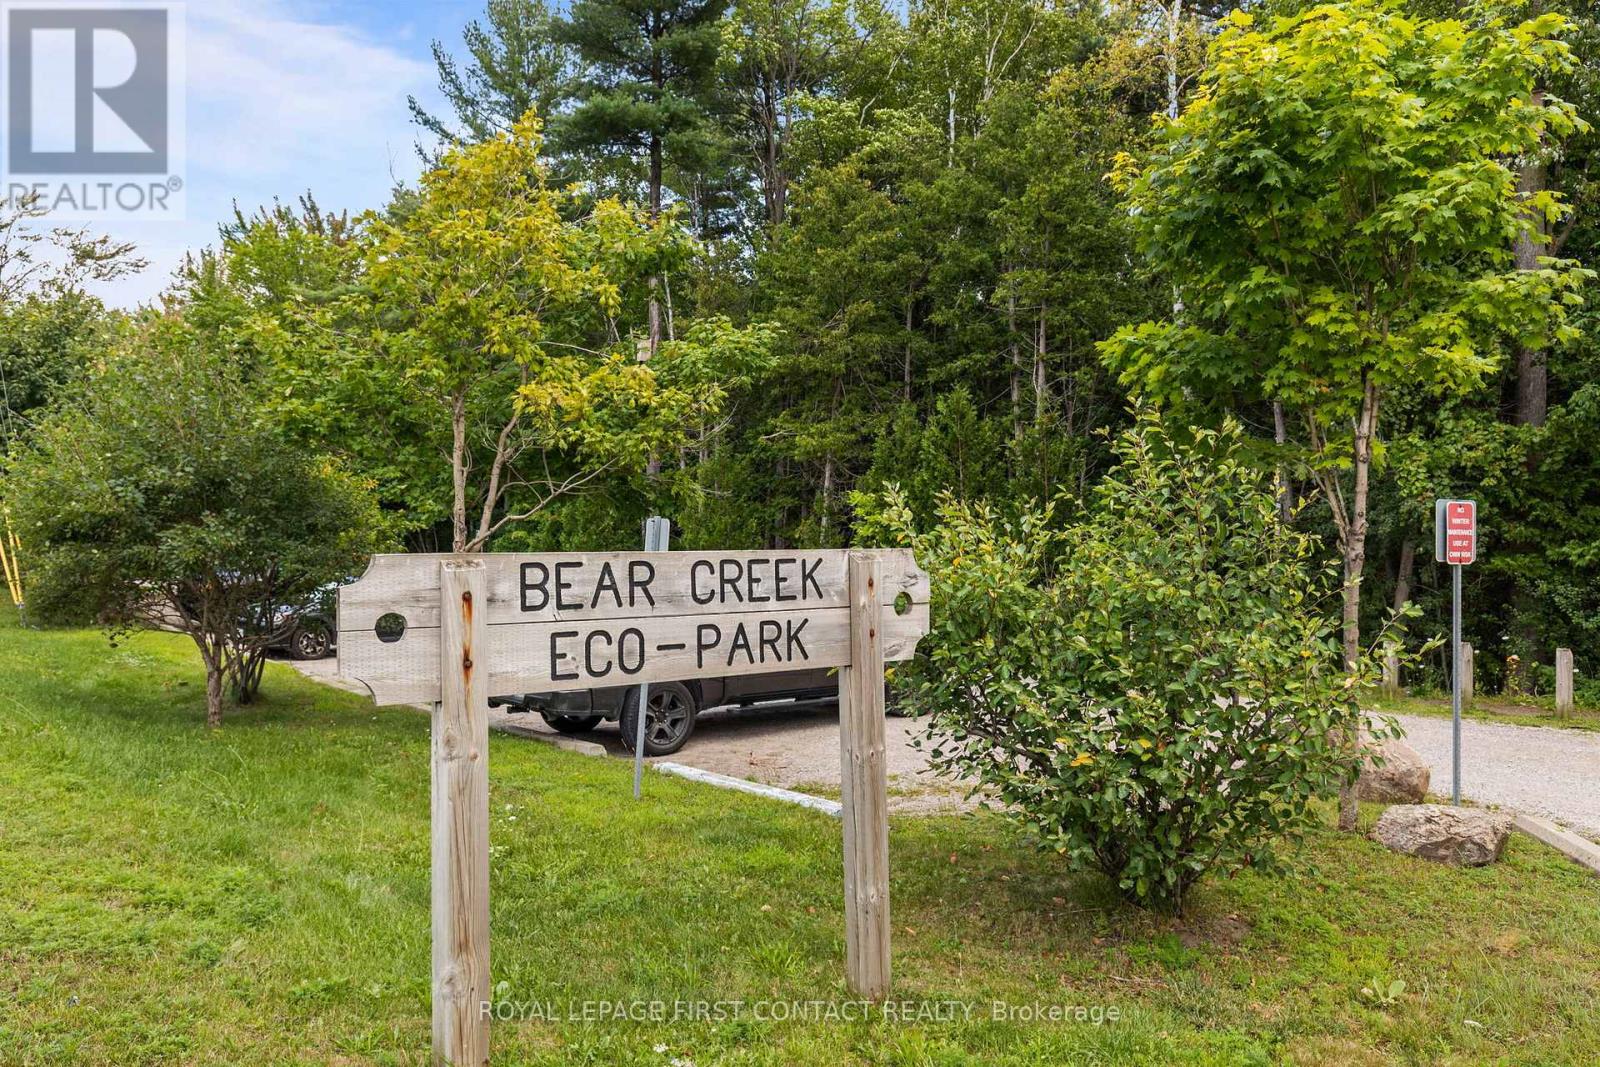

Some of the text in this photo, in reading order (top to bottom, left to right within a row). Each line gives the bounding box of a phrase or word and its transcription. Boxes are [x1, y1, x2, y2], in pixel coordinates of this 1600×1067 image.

[520, 558, 823, 612] BEAR CREEK
[550, 618, 809, 681] ECO-PARK
